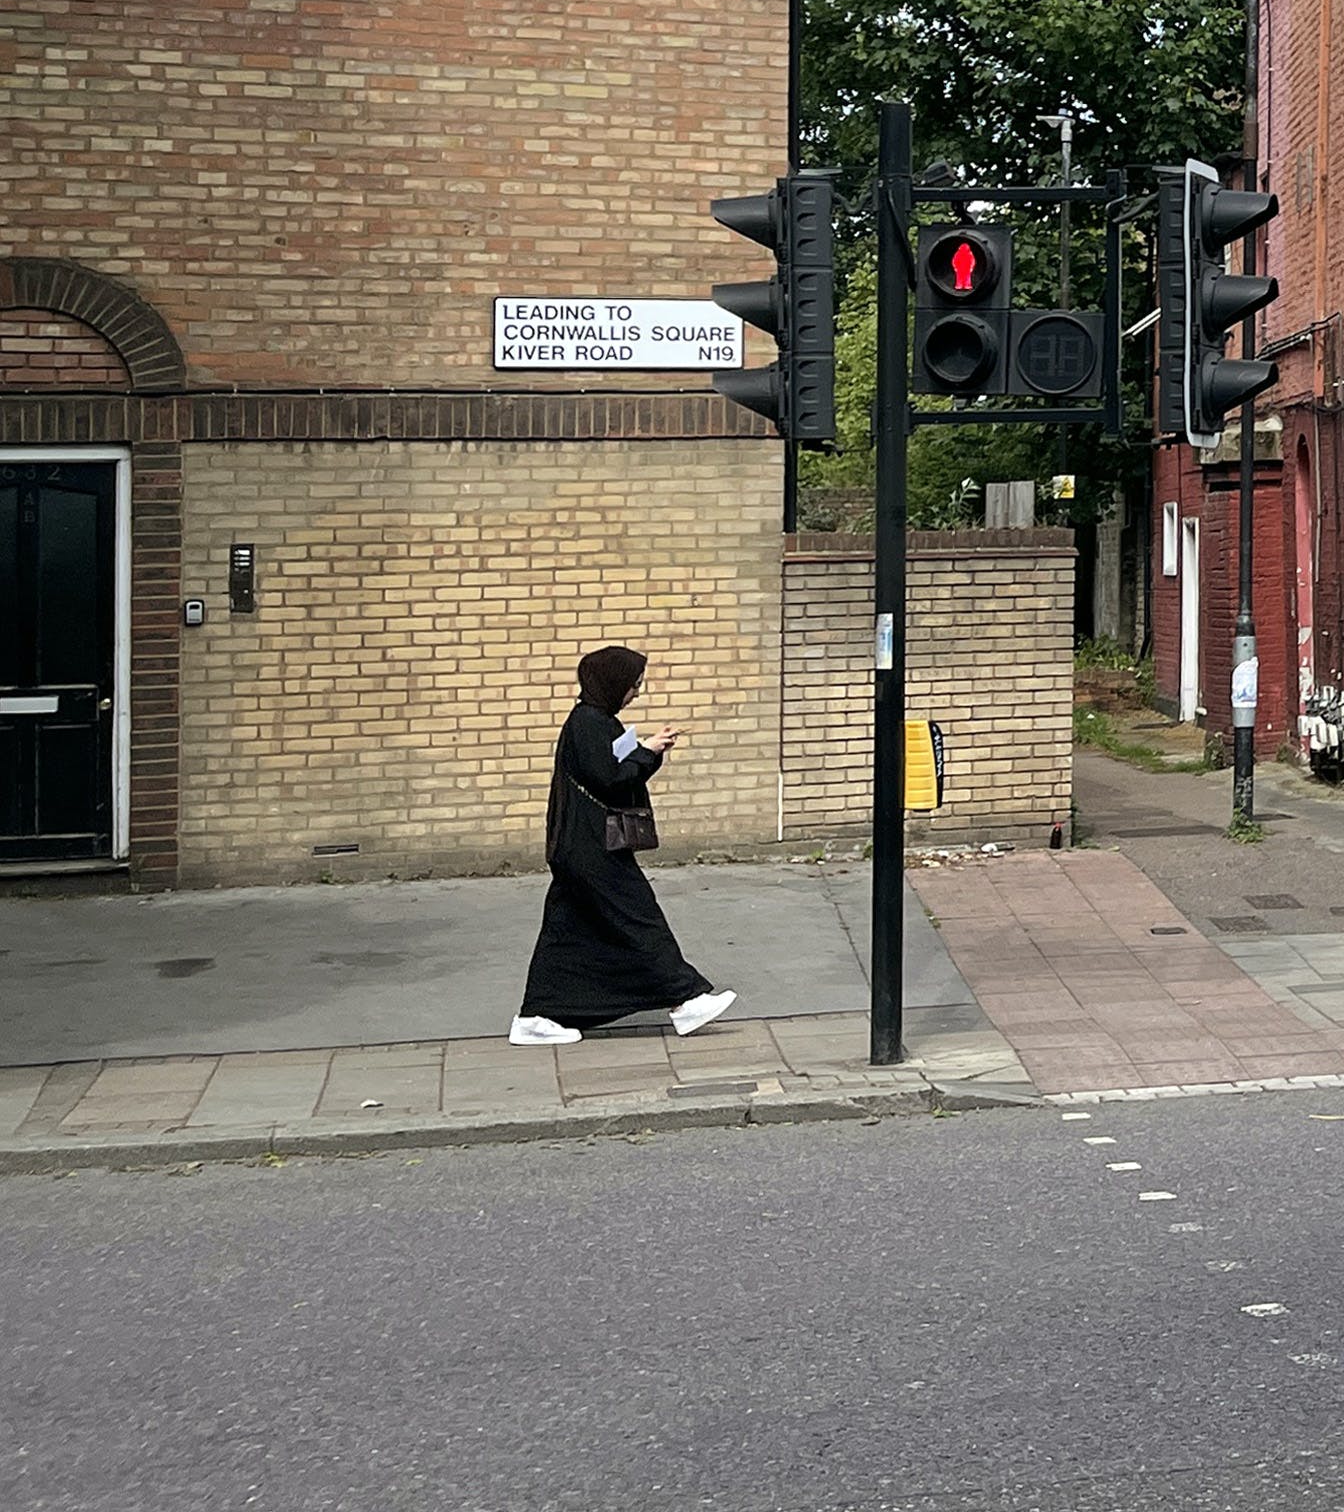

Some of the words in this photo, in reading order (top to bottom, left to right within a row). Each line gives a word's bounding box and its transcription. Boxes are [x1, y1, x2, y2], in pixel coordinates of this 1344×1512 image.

[503, 305, 595, 320] LEADING
[605, 305, 631, 320] TO
[504, 325, 640, 341] CORNWALLIS
[651, 326, 735, 341] SQUARE
[502, 345, 565, 360] KIVER
[575, 345, 633, 360] ROAD
